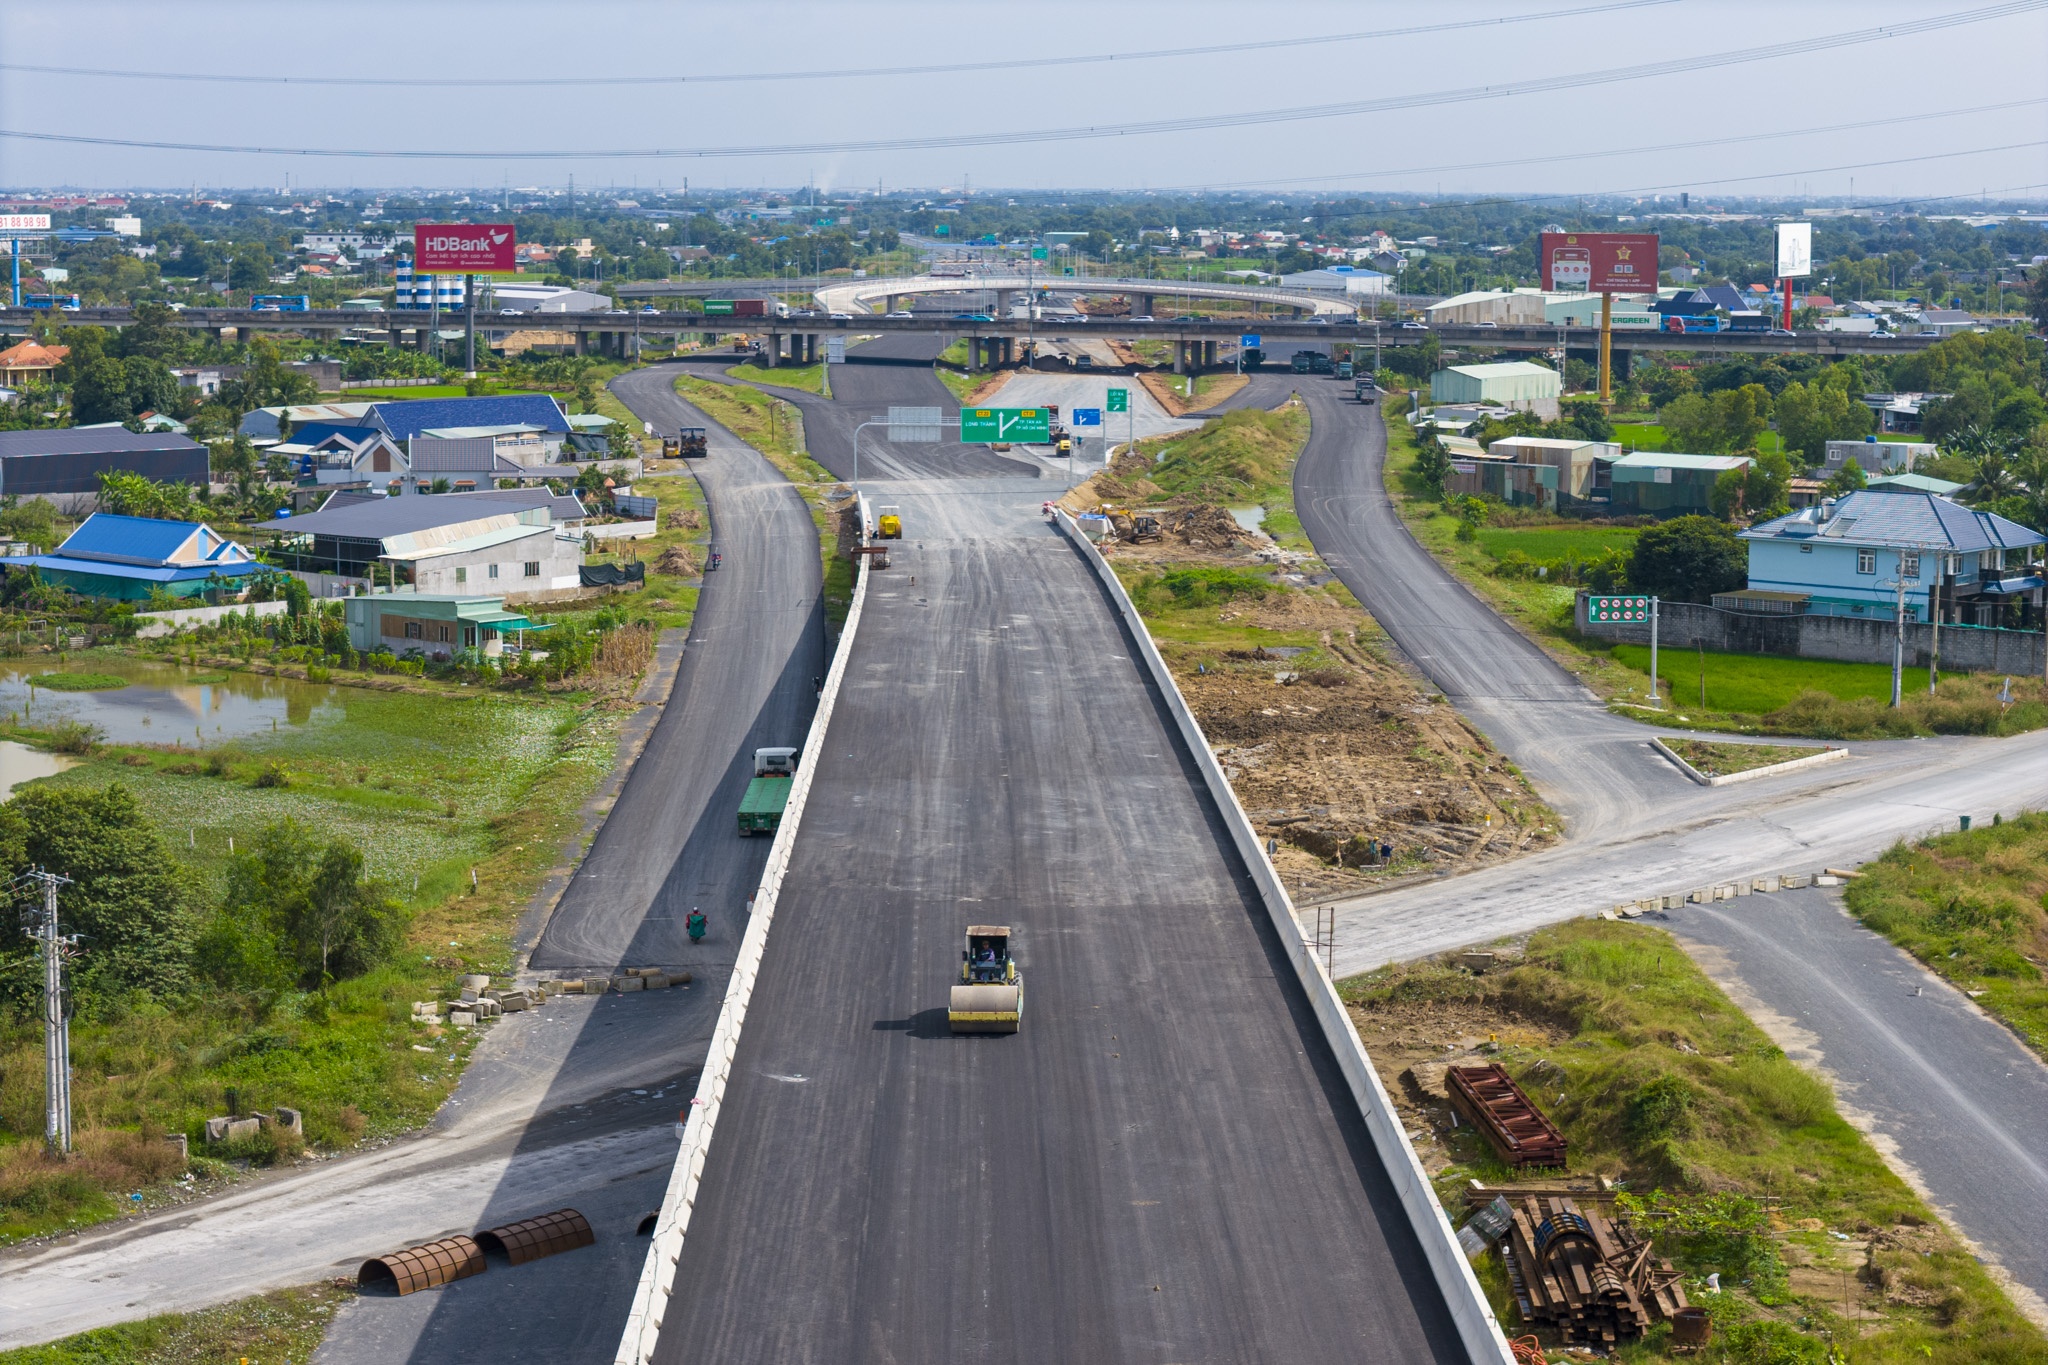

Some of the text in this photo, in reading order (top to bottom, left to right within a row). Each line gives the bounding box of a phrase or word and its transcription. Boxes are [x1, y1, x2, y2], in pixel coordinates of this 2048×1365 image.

[11, 217, 21, 227] 88
[24, 217, 34, 227] 98
[36, 217, 47, 227] 98
[425, 237, 490, 251] HDBank
